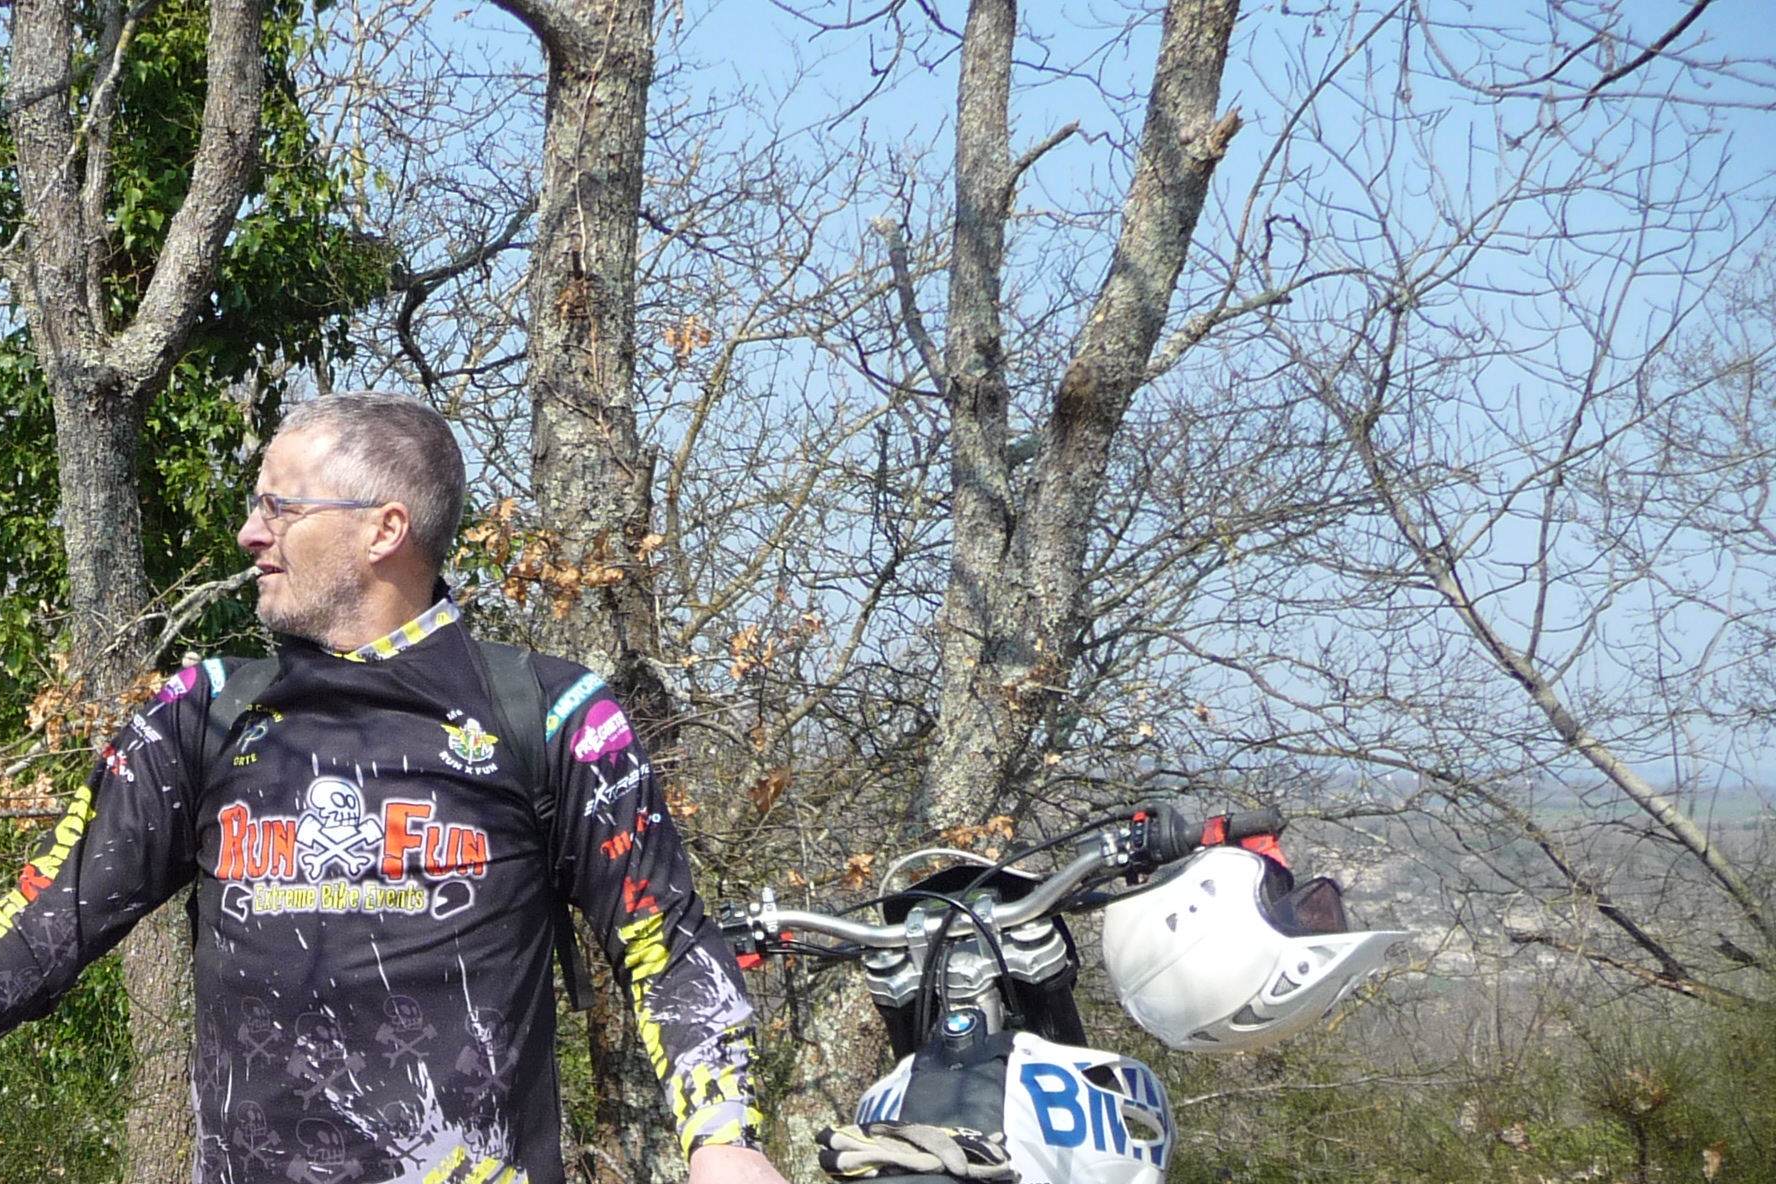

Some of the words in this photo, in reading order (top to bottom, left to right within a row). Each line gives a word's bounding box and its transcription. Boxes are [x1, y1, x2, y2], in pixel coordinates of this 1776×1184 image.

[215, 803, 297, 881] RUN
[380, 802, 489, 881] FUN
[254, 886, 316, 913] Extreme
[320, 882, 361, 911] Bike
[364, 884, 425, 912] Events
